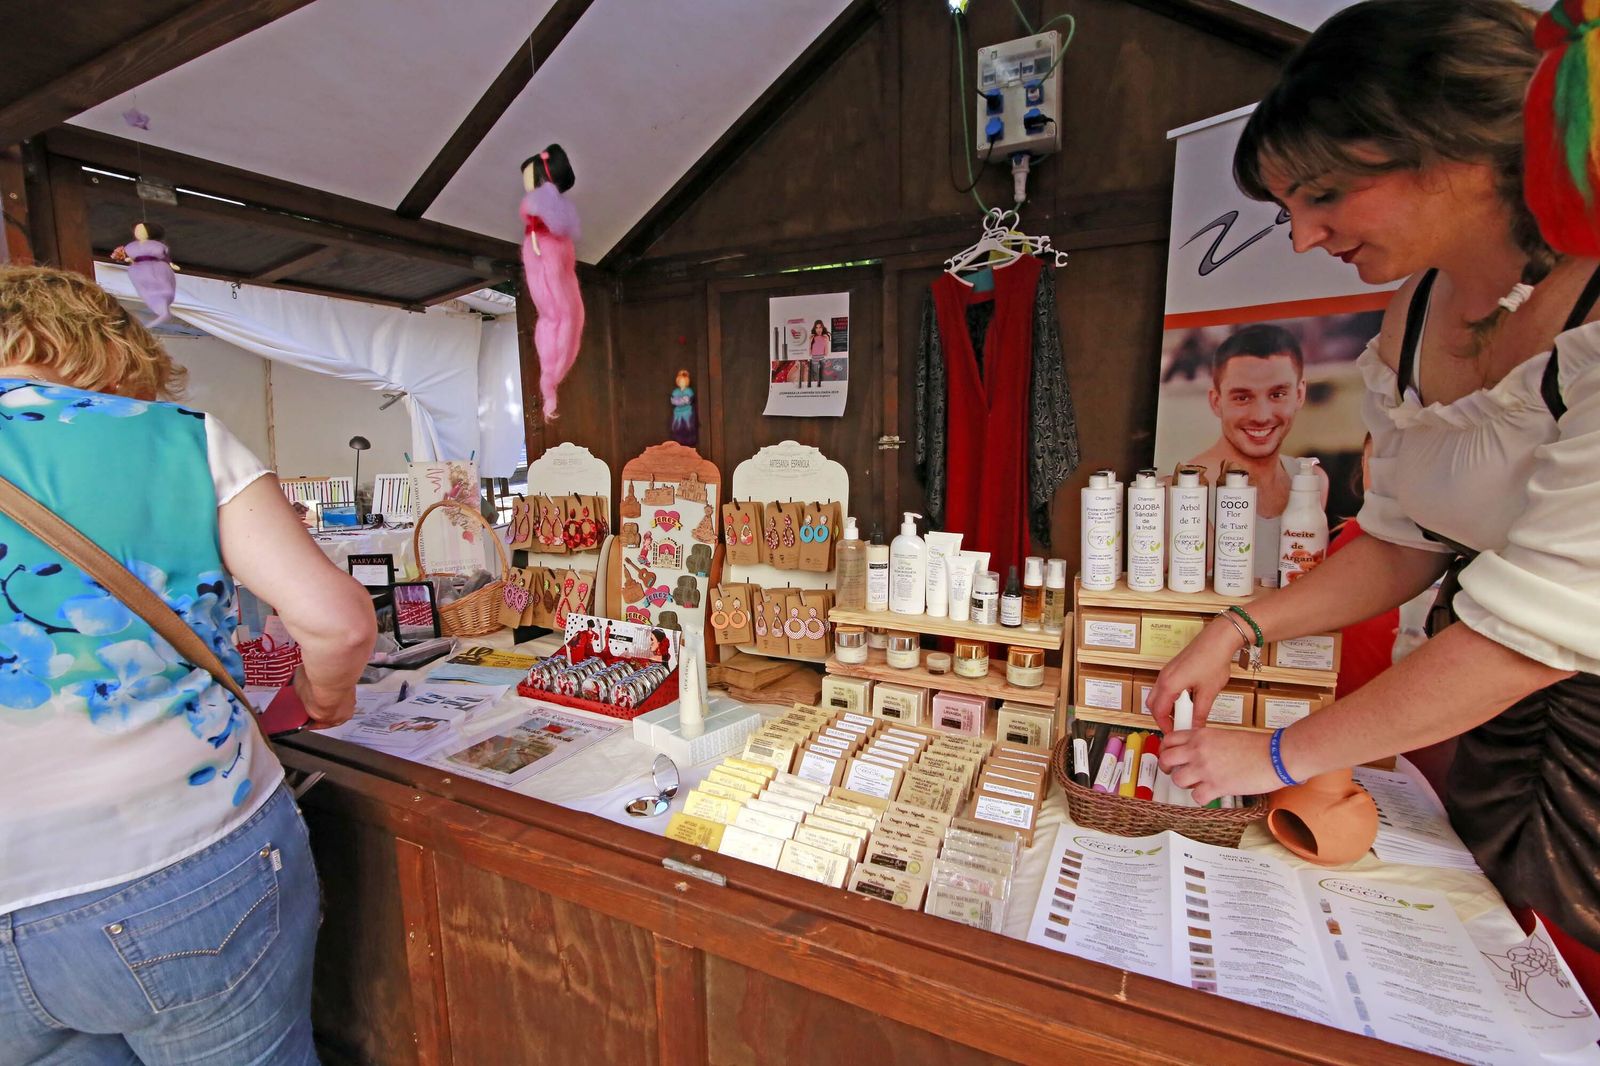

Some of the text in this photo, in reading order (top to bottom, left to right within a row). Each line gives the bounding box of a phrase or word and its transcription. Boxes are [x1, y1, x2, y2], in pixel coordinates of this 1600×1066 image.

[1132, 503, 1160, 511] JOJOBA
[1220, 500, 1249, 509] COCO
[654, 516, 678, 527] JEREZ
[1180, 516, 1189, 524] de
[1284, 530, 1315, 538] Aceite
[1282, 553, 1313, 564] Argan
[647, 591, 668, 602] JEREZ
[626, 612, 648, 624] JEREZ
[1008, 724, 1028, 732] ROMERO
